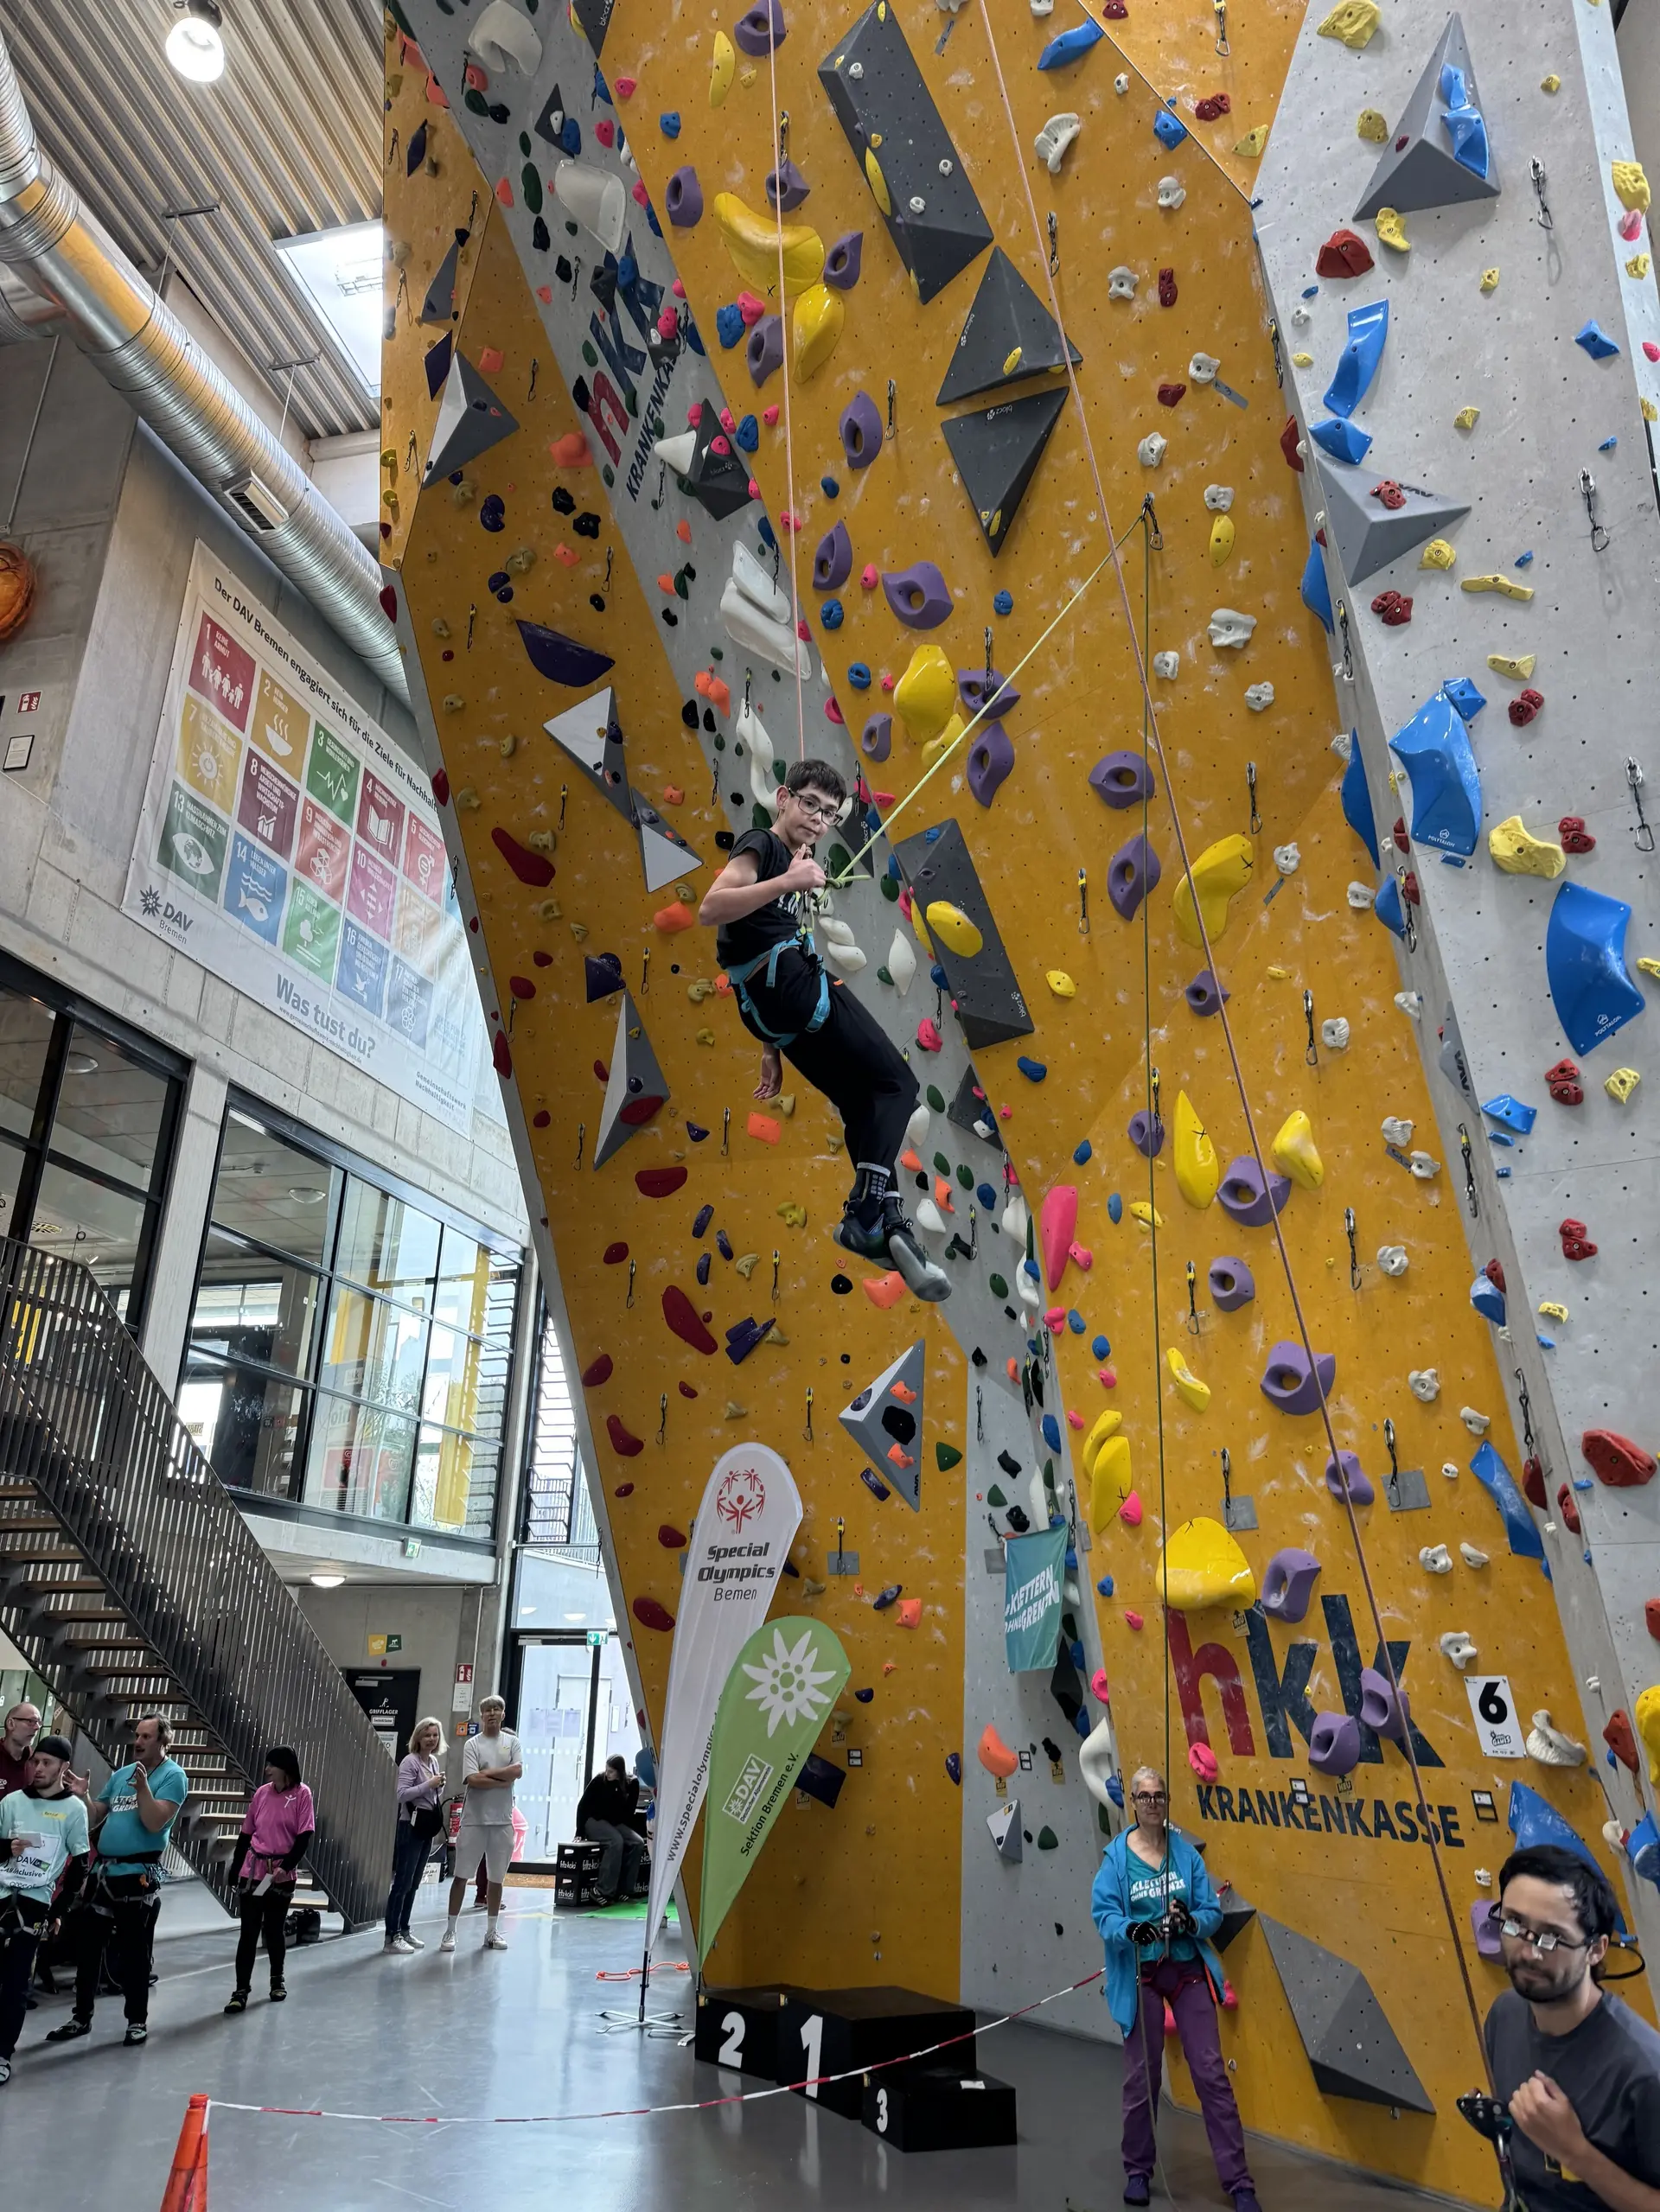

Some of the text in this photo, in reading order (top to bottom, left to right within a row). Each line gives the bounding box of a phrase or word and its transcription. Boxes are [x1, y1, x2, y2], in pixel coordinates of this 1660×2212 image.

[204, 623, 211, 641] 1
[214, 577, 232, 603] Der
[233, 597, 253, 623] DAV
[254, 618, 289, 662] Bremen
[290, 660, 330, 704] engagiert
[332, 701, 348, 723] sich
[348, 716, 361, 735] für
[361, 730, 374, 749] die
[374, 742, 394, 768] Ziele
[395, 763, 405, 781] für
[263, 679, 271, 696] 2
[188, 704, 195, 722] 7
[317, 730, 324, 747] 3
[249, 757, 258, 776] 8
[366, 775, 373, 794] 4
[173, 791, 184, 813] 13
[304, 805, 313, 823] 9
[411, 818, 416, 835] 5
[235, 842, 247, 863] 14
[356, 849, 366, 869] 10
[295, 886, 304, 906] 15
[163, 902, 194, 932] DAV
[159, 920, 188, 944] Bremen
[346, 925, 356, 947] 16
[394, 962, 403, 982] 17
[277, 973, 376, 1058] Was tust du?
[707, 1542, 769, 1562] Special
[697, 1564, 776, 1584] Olympics
[714, 1587, 757, 1601] Bemen
[1166, 1594, 1446, 1768] hkk
[1478, 1682, 1508, 1724] 6
[736, 1758, 762, 1800] DAV
[1338, 1781, 1351, 1792] NEU
[740, 1752, 799, 1857] Sektion Bremen e.V.
[740, 1794, 759, 1822] Deutscher
[1197, 1784, 1465, 1848] KRANKENKASSE
[16, 1855, 36, 1865] DAV
[718, 2011, 745, 2069] 2
[800, 2015, 823, 2098] 1
[876, 2088, 888, 2132] 3
